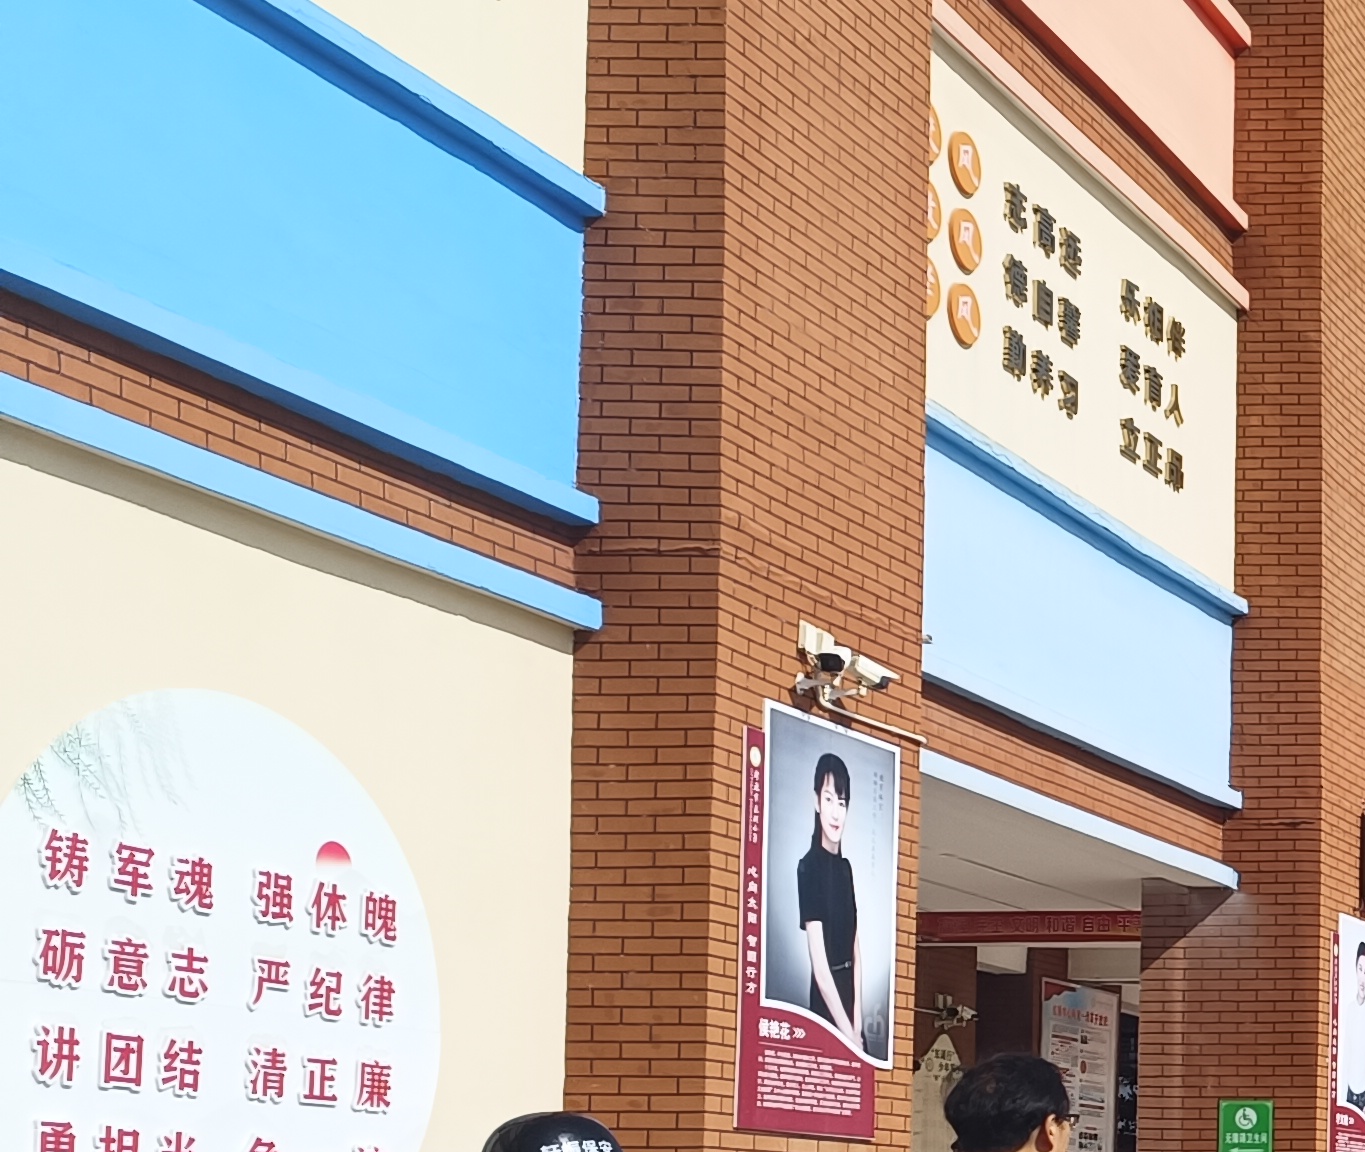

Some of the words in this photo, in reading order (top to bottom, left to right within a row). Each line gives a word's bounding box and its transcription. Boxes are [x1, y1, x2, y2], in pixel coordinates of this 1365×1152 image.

[1119, 345, 1183, 427] 爱育人
[45, 829, 214, 911] 铸军魂
[257, 870, 397, 943] 强体魄
[1082, 915, 1110, 934] 自由
[39, 929, 209, 1000] 砺意志
[252, 957, 396, 1023] 严纪律
[36, 1026, 202, 1093] 讲团结
[250, 1049, 392, 1108] 清正廉
